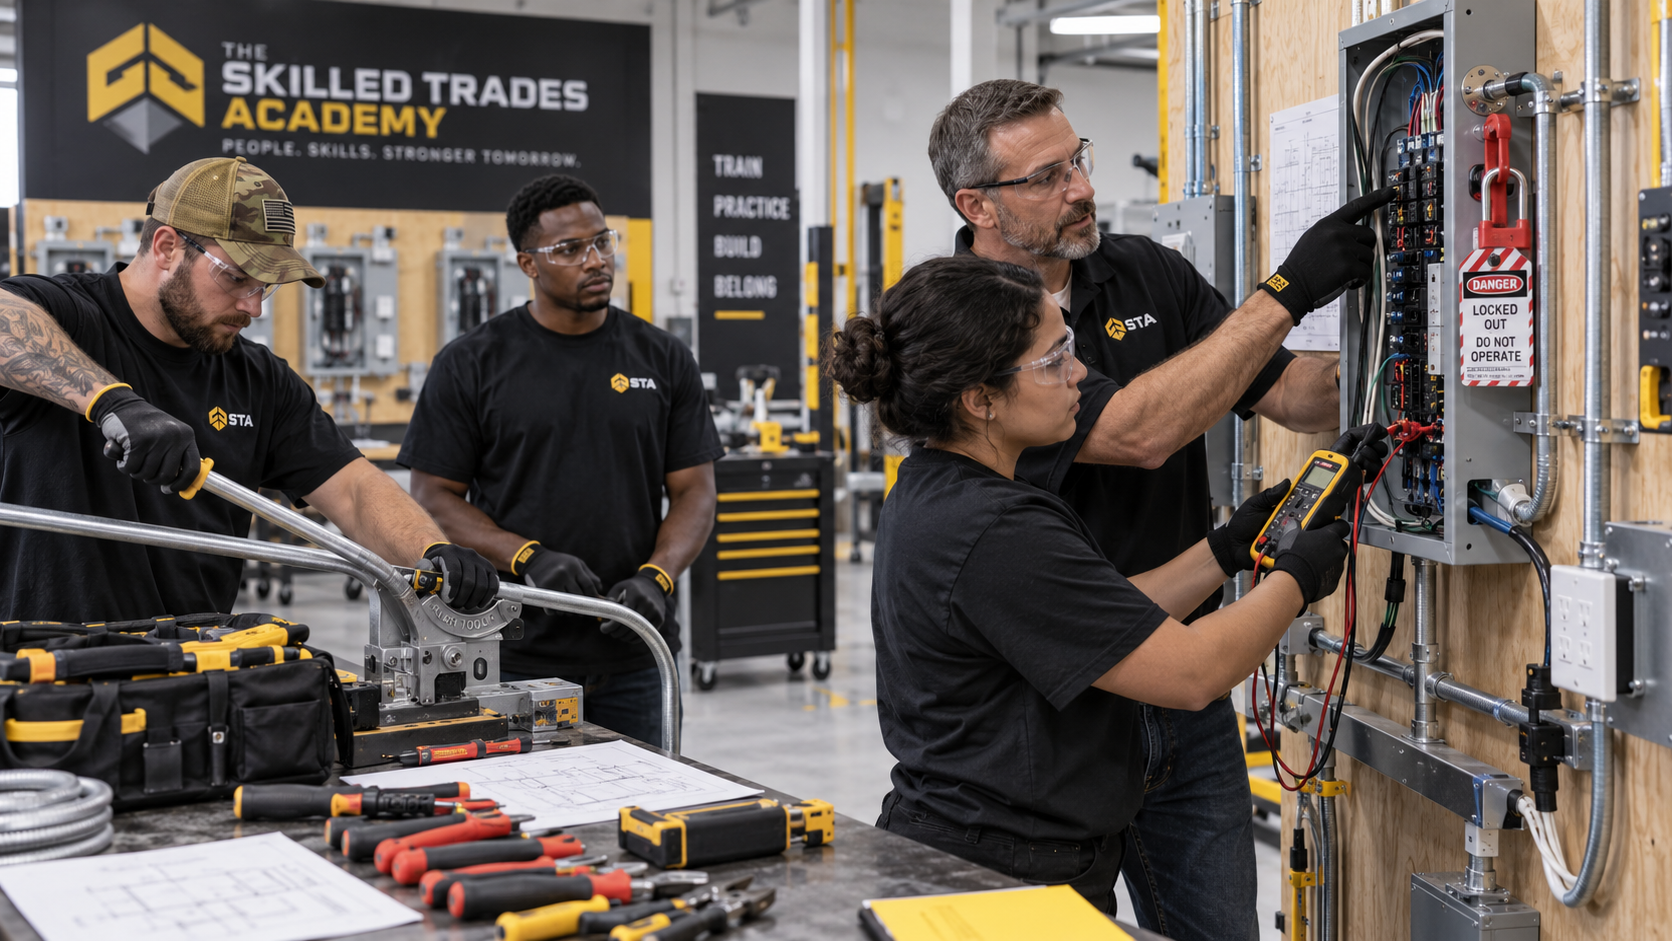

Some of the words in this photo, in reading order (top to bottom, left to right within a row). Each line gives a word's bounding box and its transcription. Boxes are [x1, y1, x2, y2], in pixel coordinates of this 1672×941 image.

[222, 41, 268, 61] THE
[221, 60, 413, 103] SKILLED
[421, 71, 589, 112] TRADES
[221, 97, 447, 139] ACADEMY
[222, 138, 302, 157] PEOPLE.
[307, 142, 377, 160] SKILLS.
[382, 145, 476, 164] STRONGER
[481, 149, 581, 168] TOMORROW.
[712, 154, 763, 179] TRAIN
[713, 194, 791, 220] PRACTICE
[713, 234, 762, 259] BUILD
[713, 275, 777, 299] BELONG
[1472, 278, 1518, 291] DANGER
[1472, 304, 1519, 316] LOCKED
[1124, 313, 1158, 331] STA
[1484, 319, 1507, 330] OUT
[1476, 337, 1491, 348] DO
[1494, 337, 1516, 348] NOT
[1471, 351, 1521, 363] OPERATE
[630, 377, 657, 390] STA
[228, 413, 254, 427] STA
